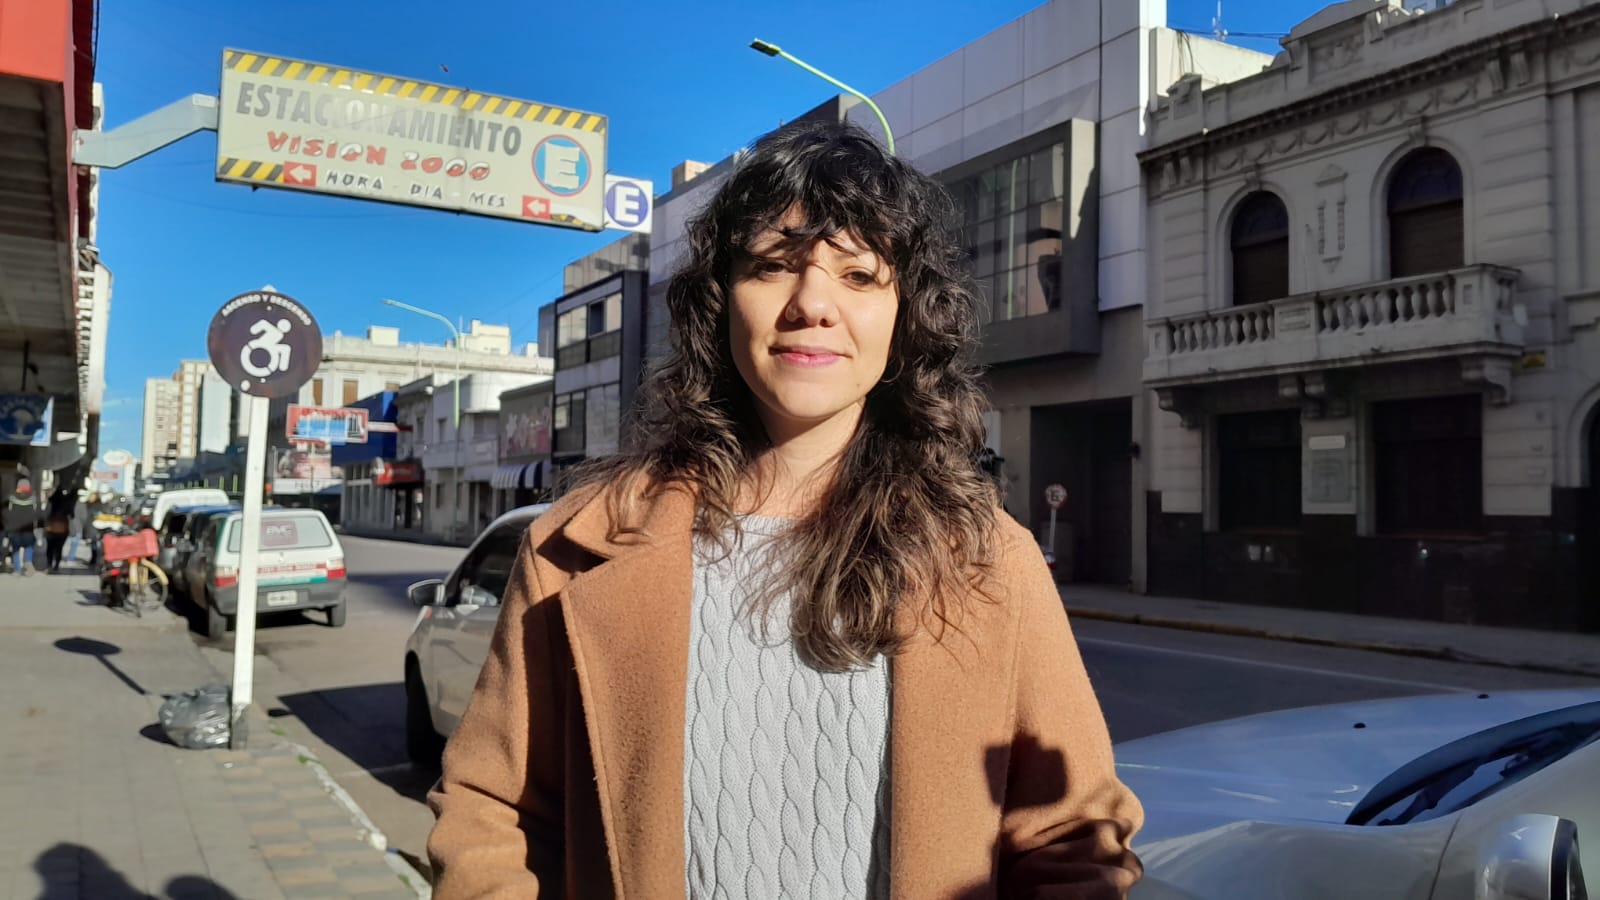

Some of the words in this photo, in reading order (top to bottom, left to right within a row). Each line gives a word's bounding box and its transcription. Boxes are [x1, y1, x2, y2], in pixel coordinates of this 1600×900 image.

[266, 131, 388, 166] VISION
[400, 151, 491, 182] 2000
[544, 141, 580, 190] E
[326, 170, 383, 190] HORA
[410, 183, 443, 200] DIA
[469, 191, 508, 208] MES
[613, 184, 640, 224] E
[262, 294, 269, 303] Y
